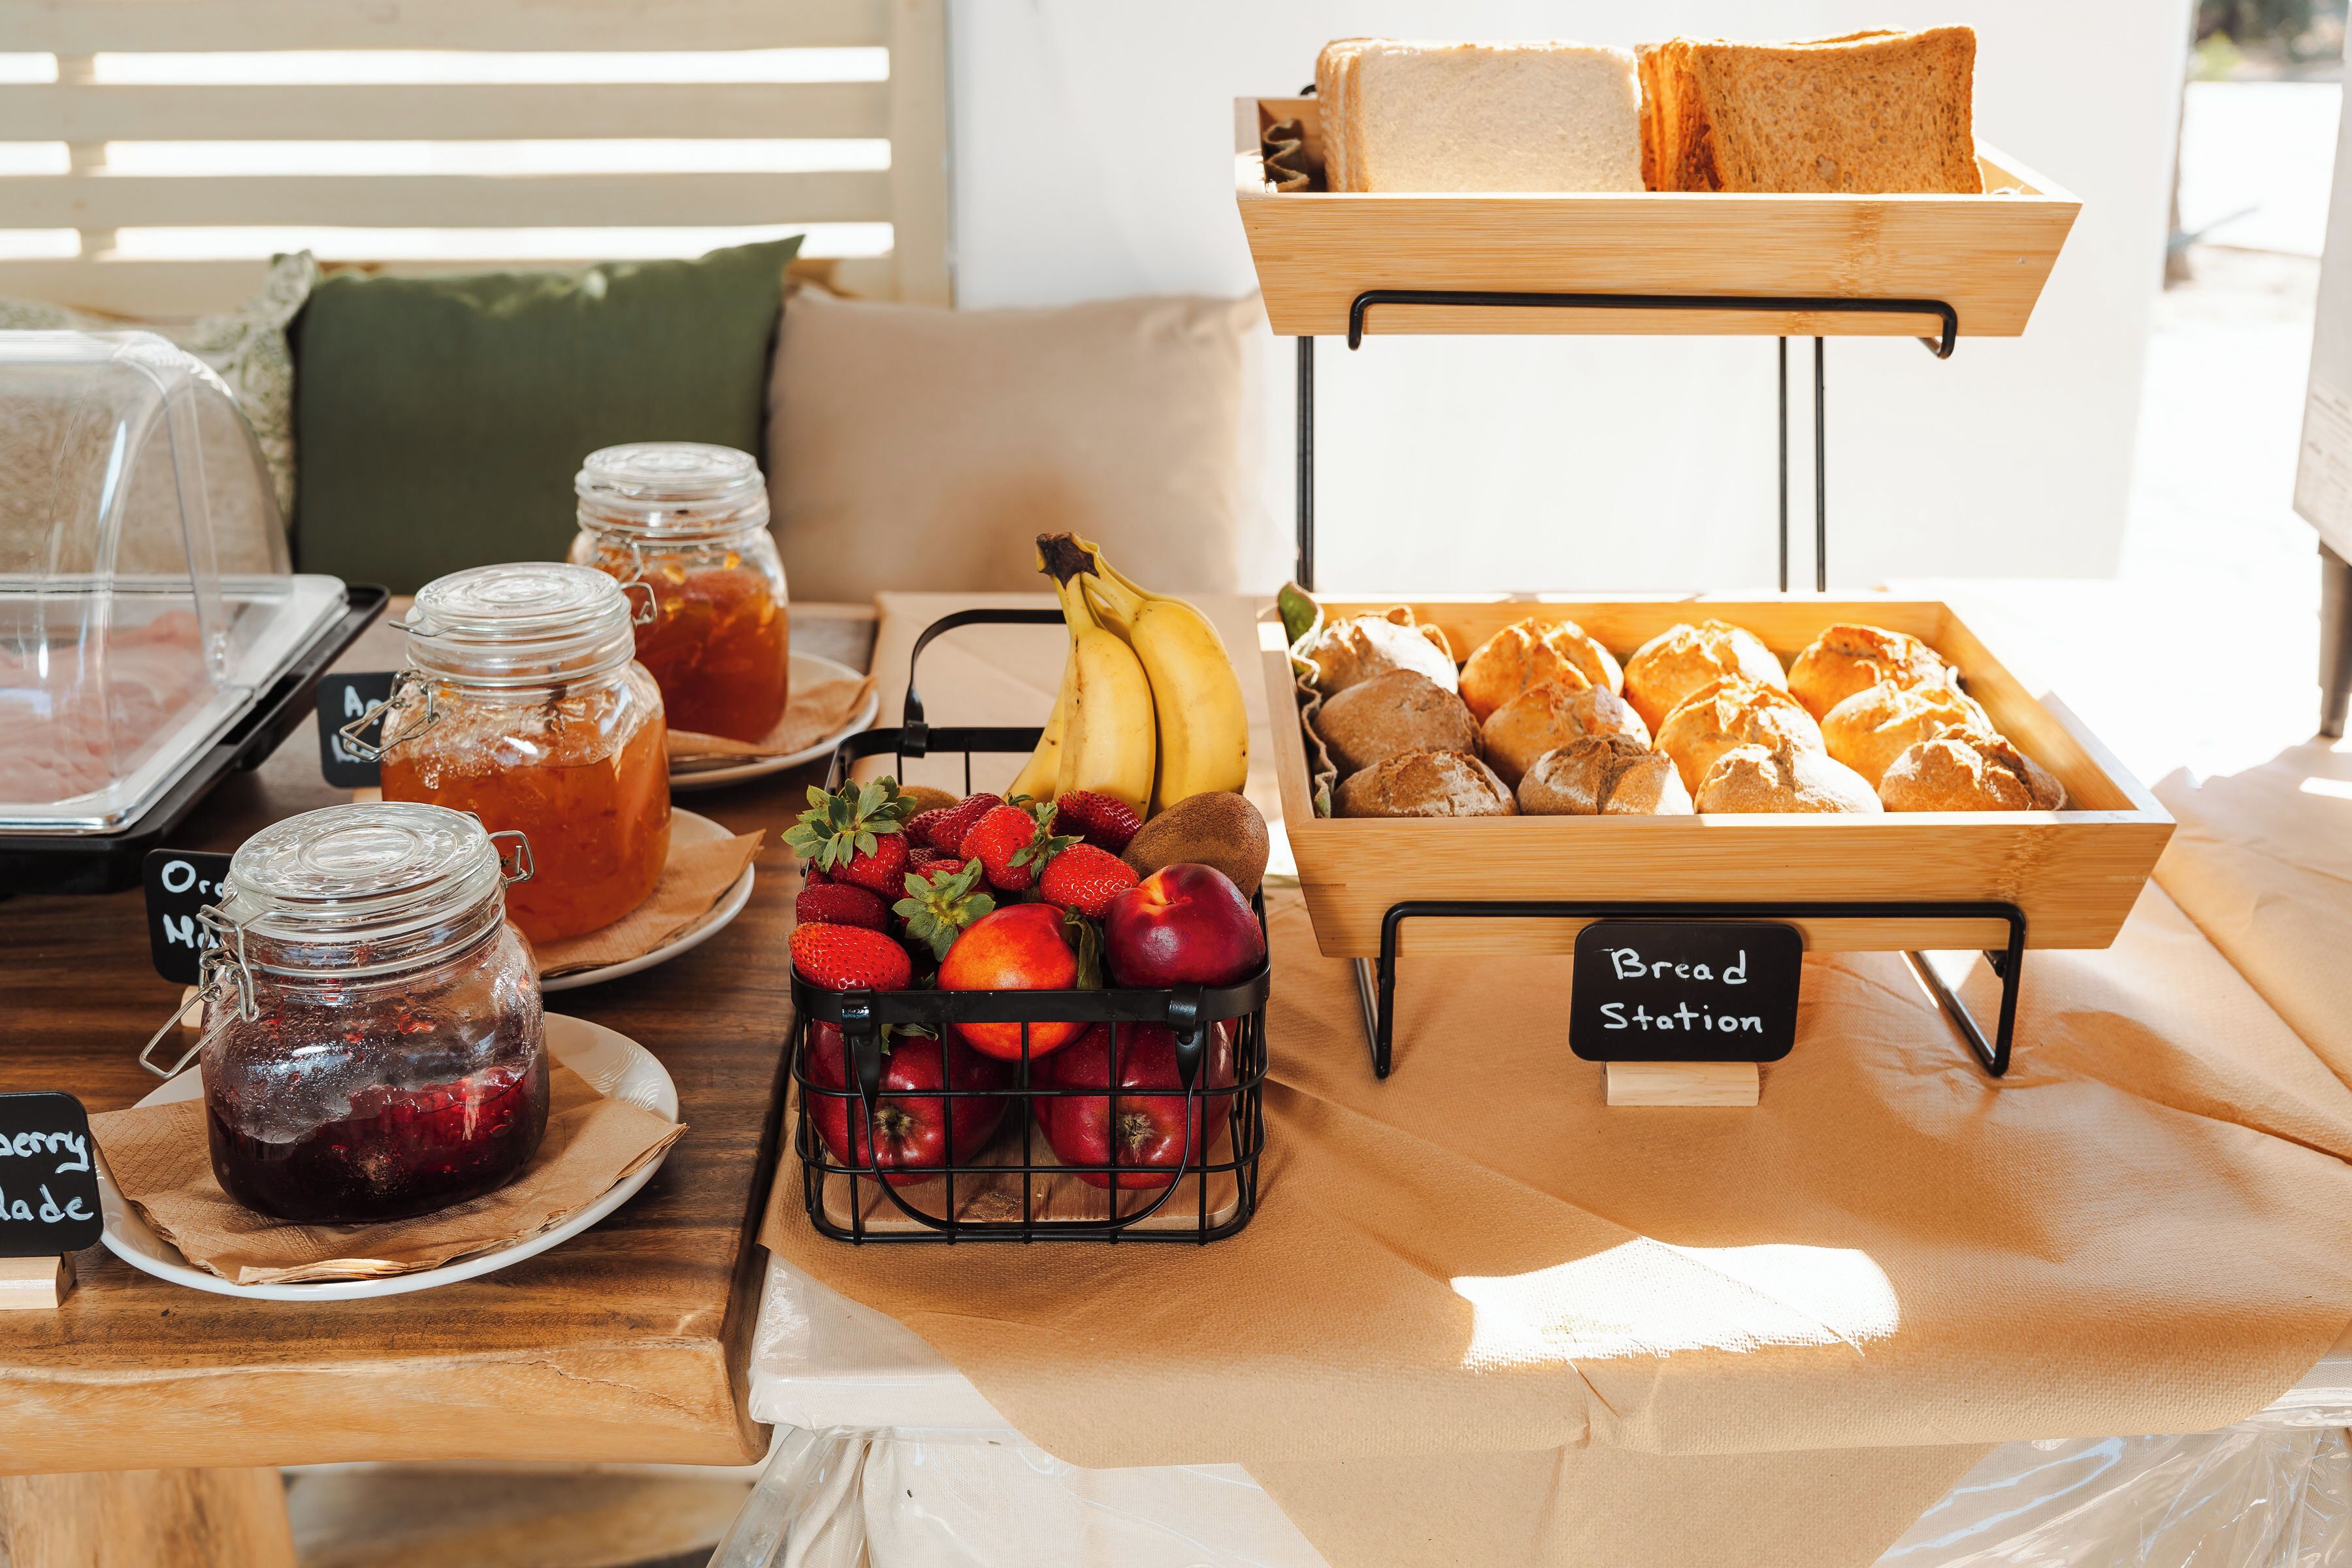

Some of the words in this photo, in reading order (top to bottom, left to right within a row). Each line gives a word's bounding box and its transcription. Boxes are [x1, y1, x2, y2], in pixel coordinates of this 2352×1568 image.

[163, 914, 223, 949] Ma
[1611, 948, 1746, 984] Bread
[1601, 1002, 1763, 1033] Station
